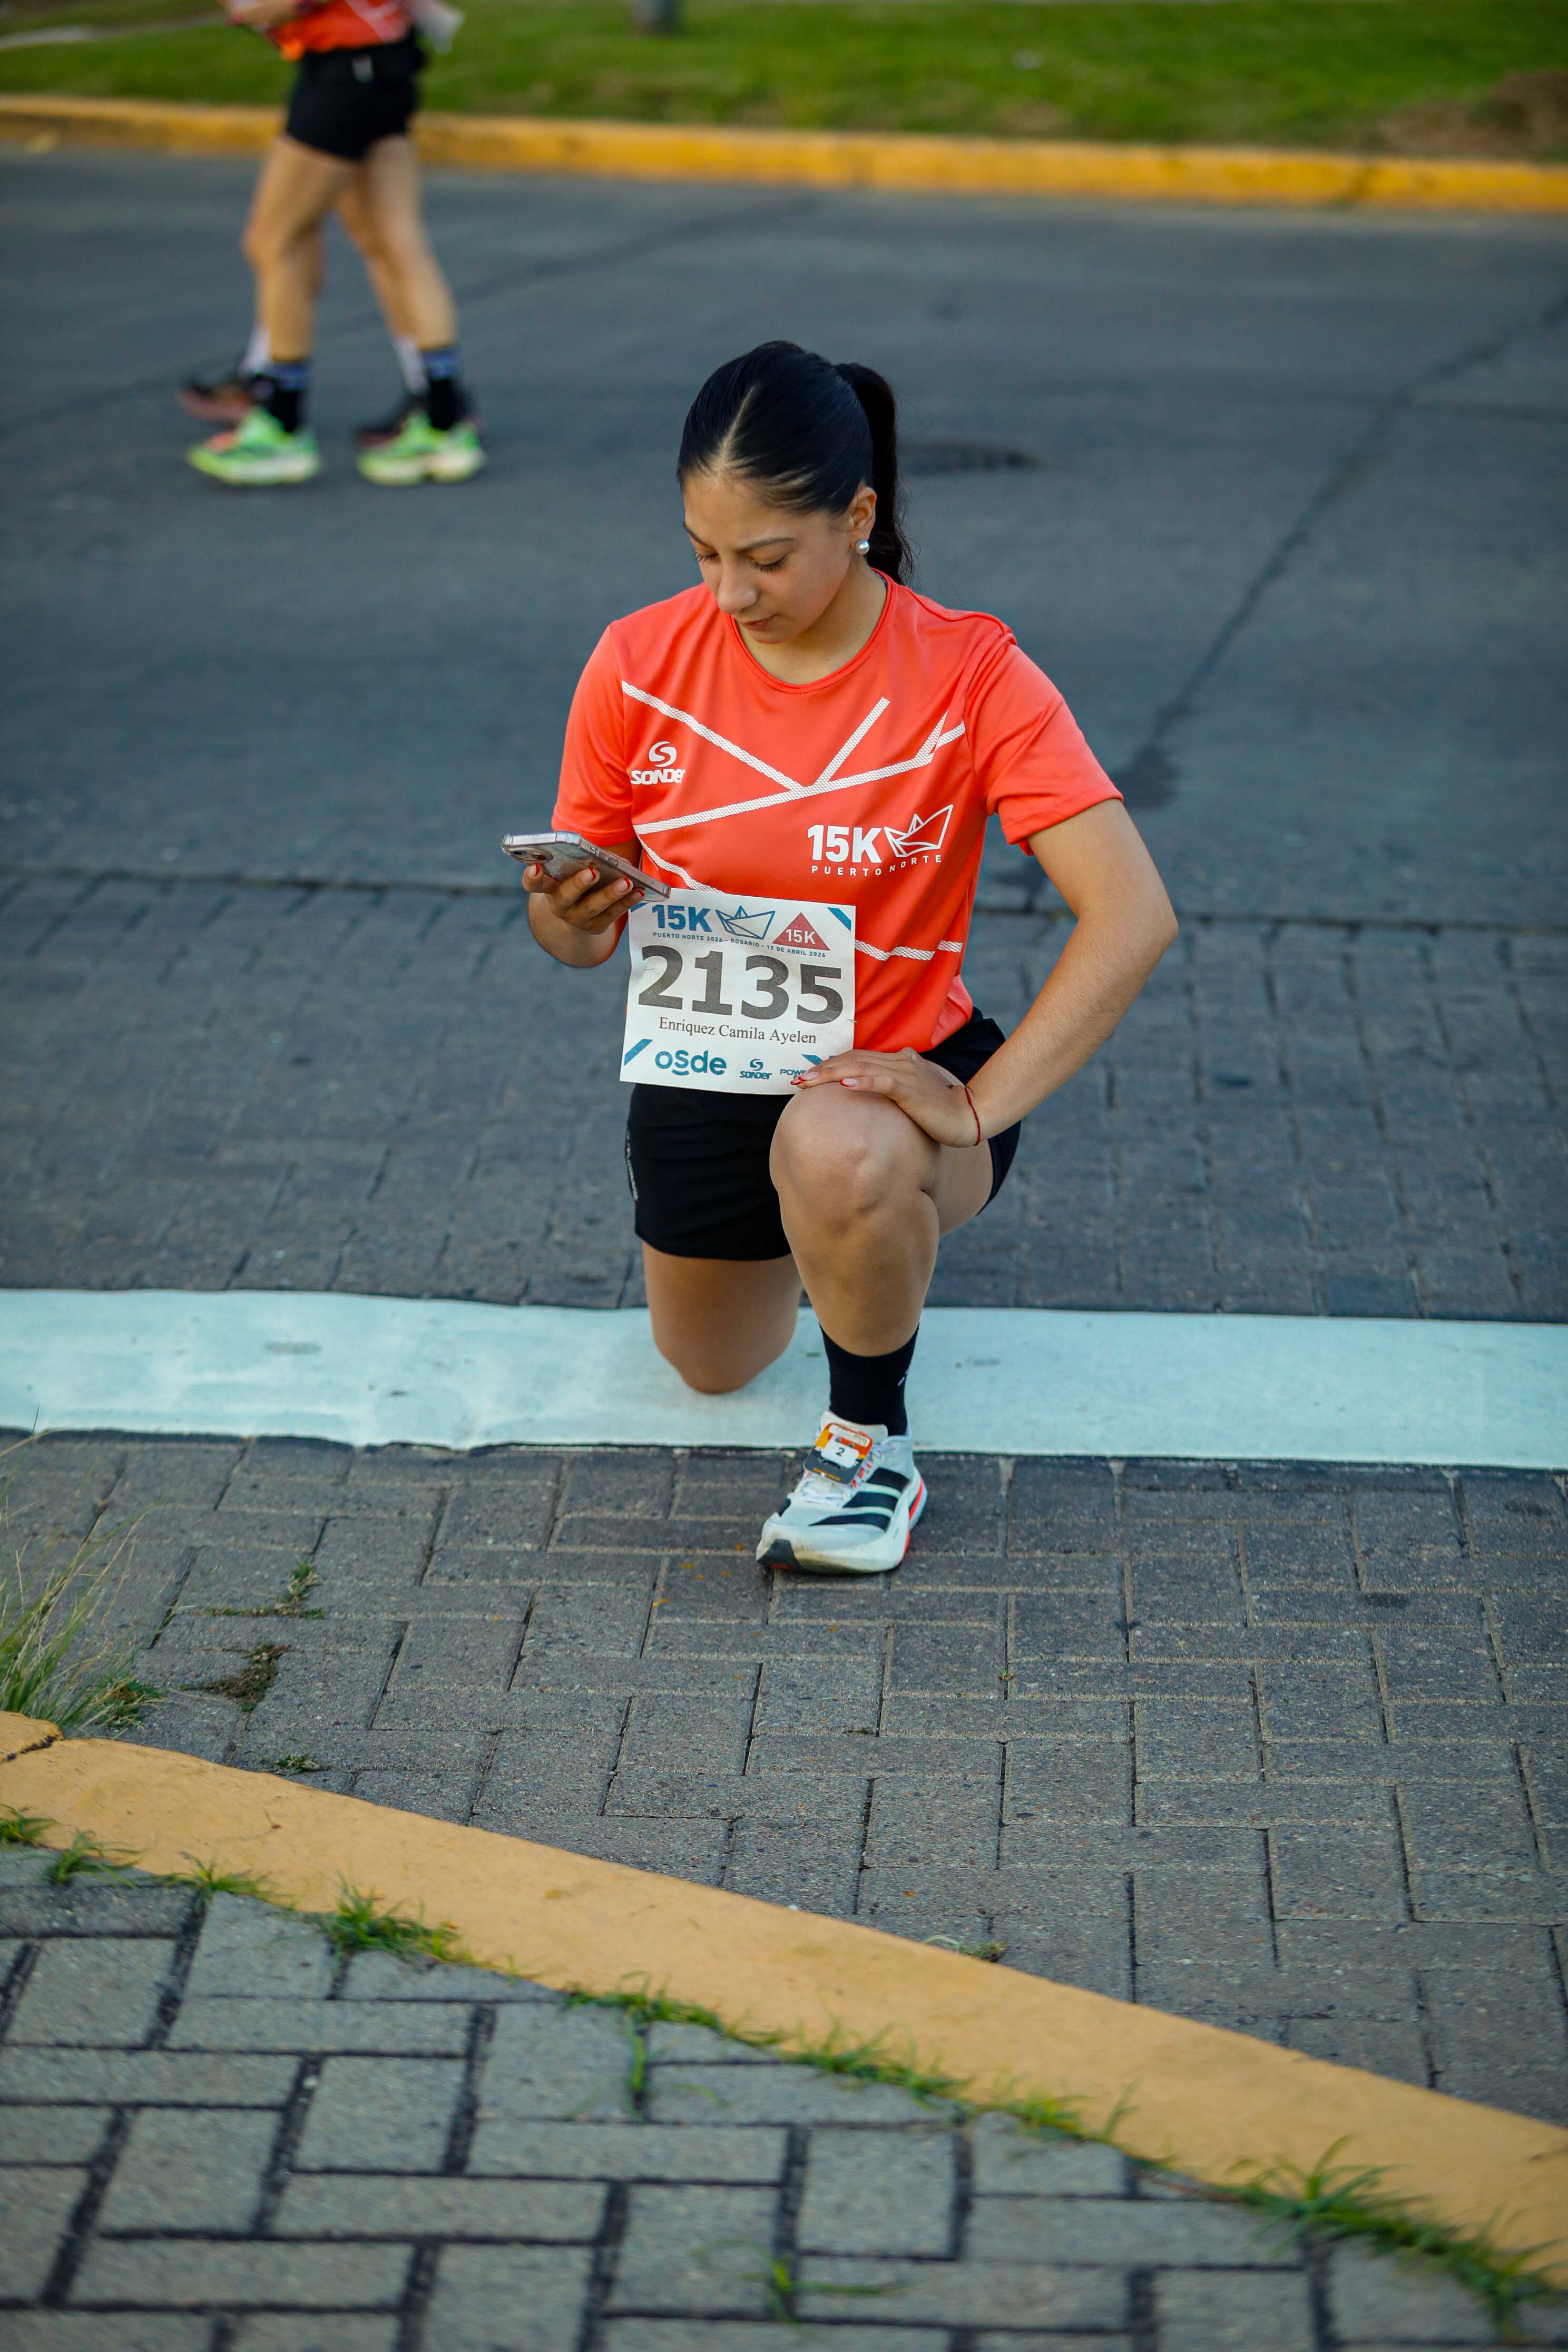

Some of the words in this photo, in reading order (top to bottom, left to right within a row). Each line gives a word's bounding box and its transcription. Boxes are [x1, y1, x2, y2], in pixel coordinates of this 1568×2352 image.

[807, 824, 883, 863] 15K
[811, 865, 881, 876] PUERTO
[889, 855, 942, 873] NORTE
[651, 904, 712, 933] 15K
[730, 938, 759, 947] ROSARIO
[786, 928, 817, 945] 15K
[638, 945, 844, 1024] 2135
[659, 1016, 715, 1036] Enriquez
[719, 1024, 765, 1040] Camila
[769, 1028, 817, 1044] Ayelen
